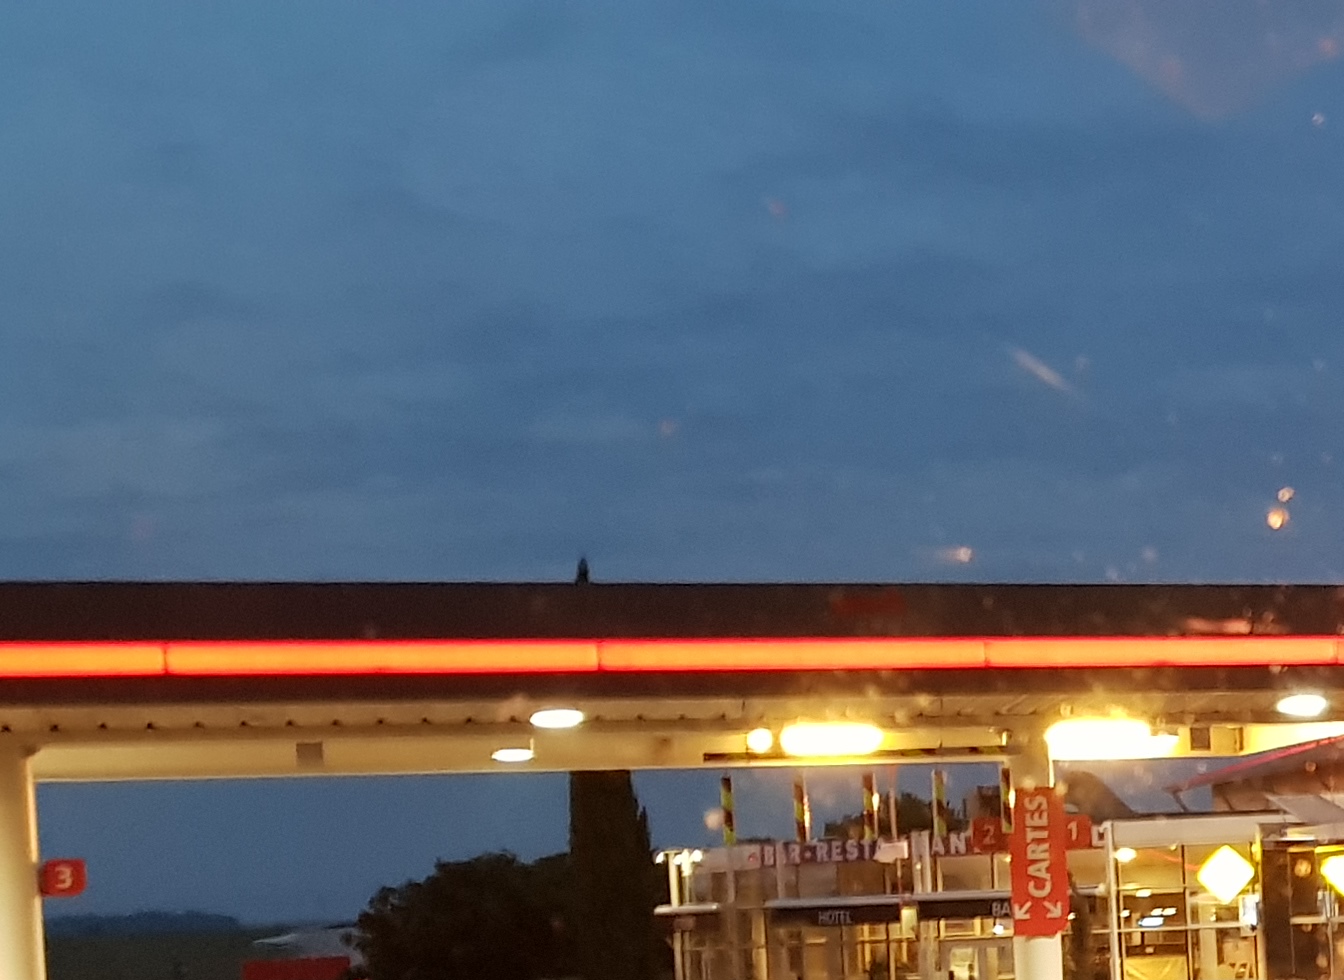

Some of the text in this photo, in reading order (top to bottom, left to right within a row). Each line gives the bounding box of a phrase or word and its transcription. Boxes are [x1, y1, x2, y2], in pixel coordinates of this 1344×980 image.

[982, 824, 996, 845] 2
[1066, 820, 1079, 842] 1
[1023, 795, 1053, 899] CARTES
[54, 865, 74, 890] 3
